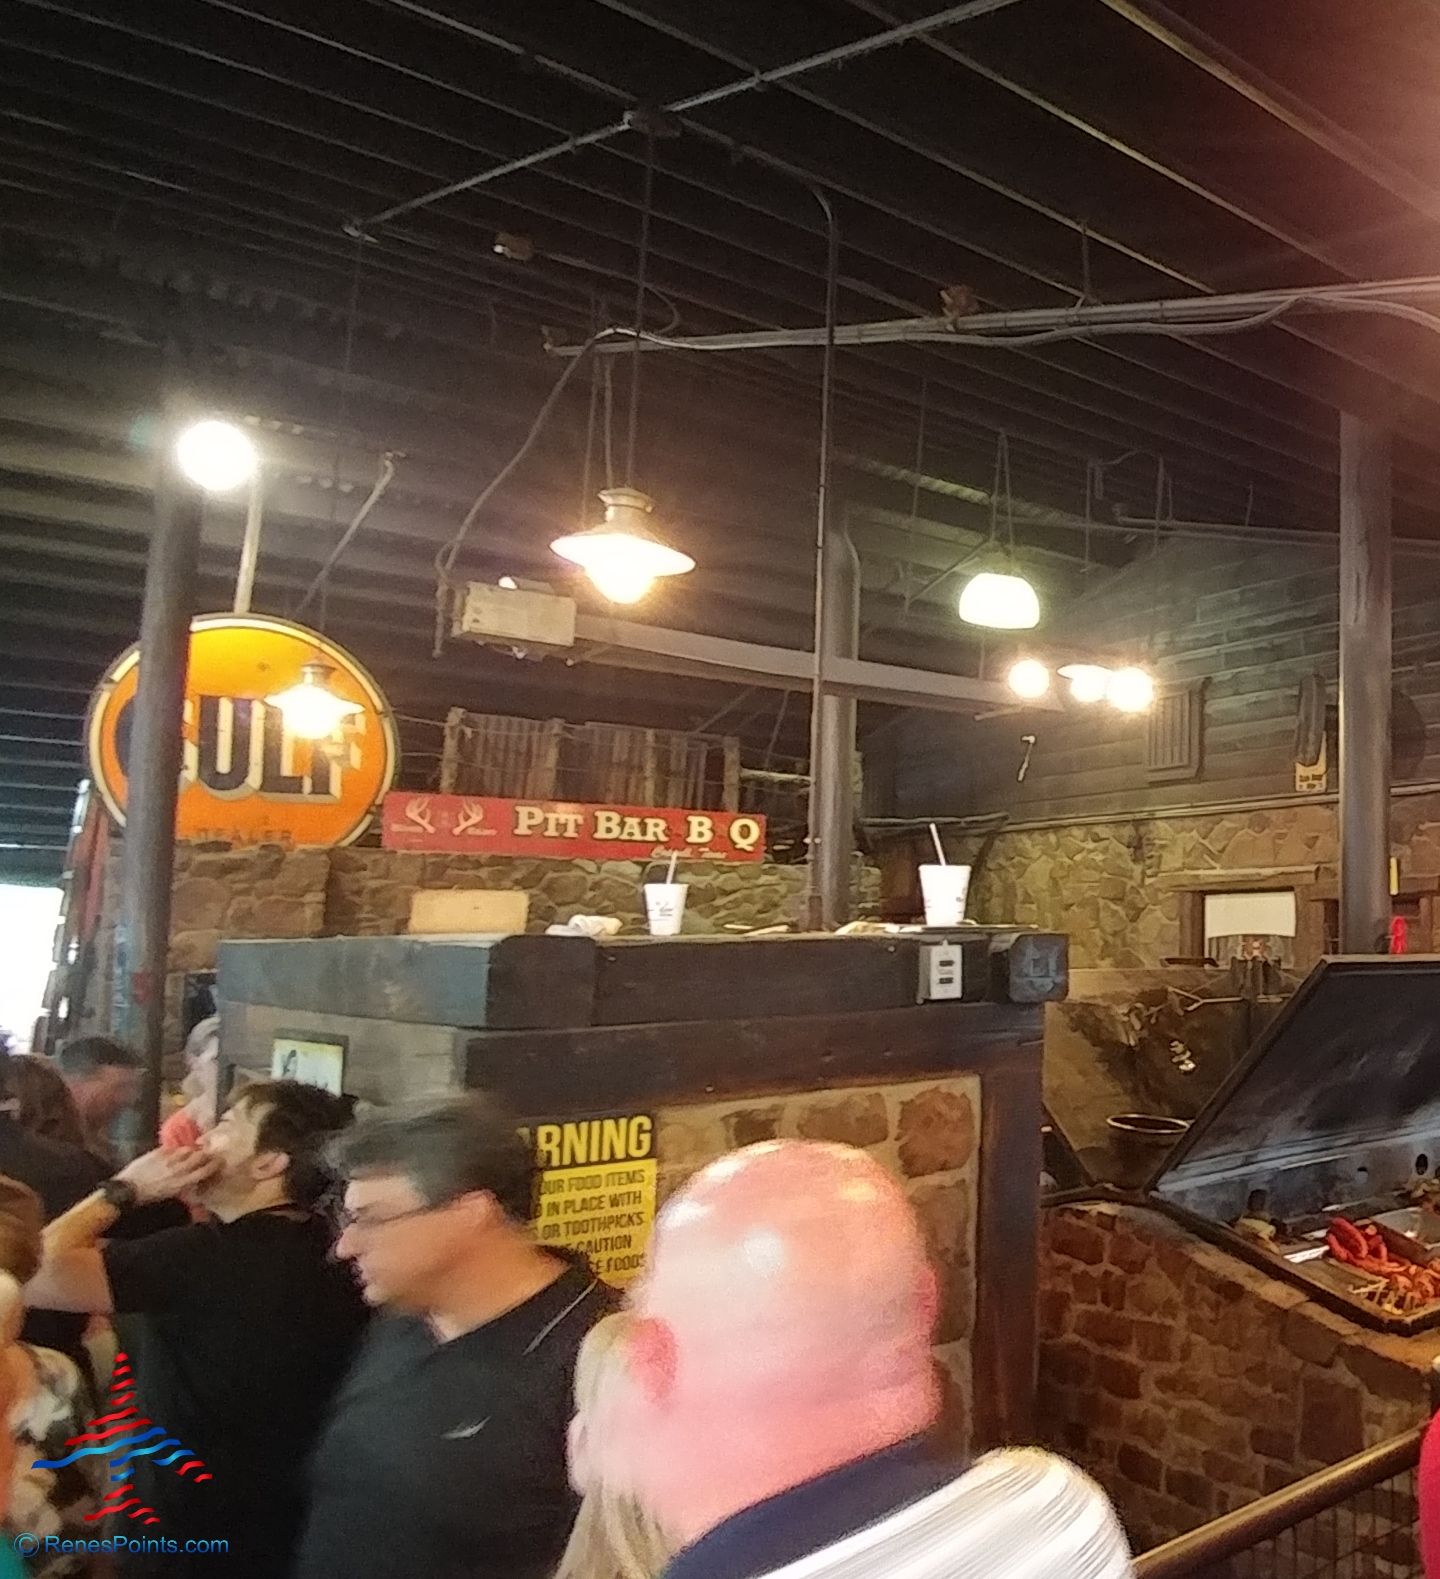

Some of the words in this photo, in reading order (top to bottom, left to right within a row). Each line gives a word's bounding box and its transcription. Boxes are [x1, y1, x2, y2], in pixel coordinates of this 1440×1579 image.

[513, 805, 585, 839] PIT
[592, 810, 670, 843] BAR
[685, 814, 714, 844] B
[729, 817, 760, 852] Q
[568, 1175, 602, 1191] FOOD
[604, 1169, 646, 1188] ITEMS
[546, 1202, 560, 1217] IN
[563, 1195, 606, 1216] PLACE
[608, 1190, 643, 1209] WITH
[541, 1222, 561, 1240] OR
[563, 1211, 646, 1237] TOOTHPICKS
[576, 1234, 633, 1255] CAUTION
